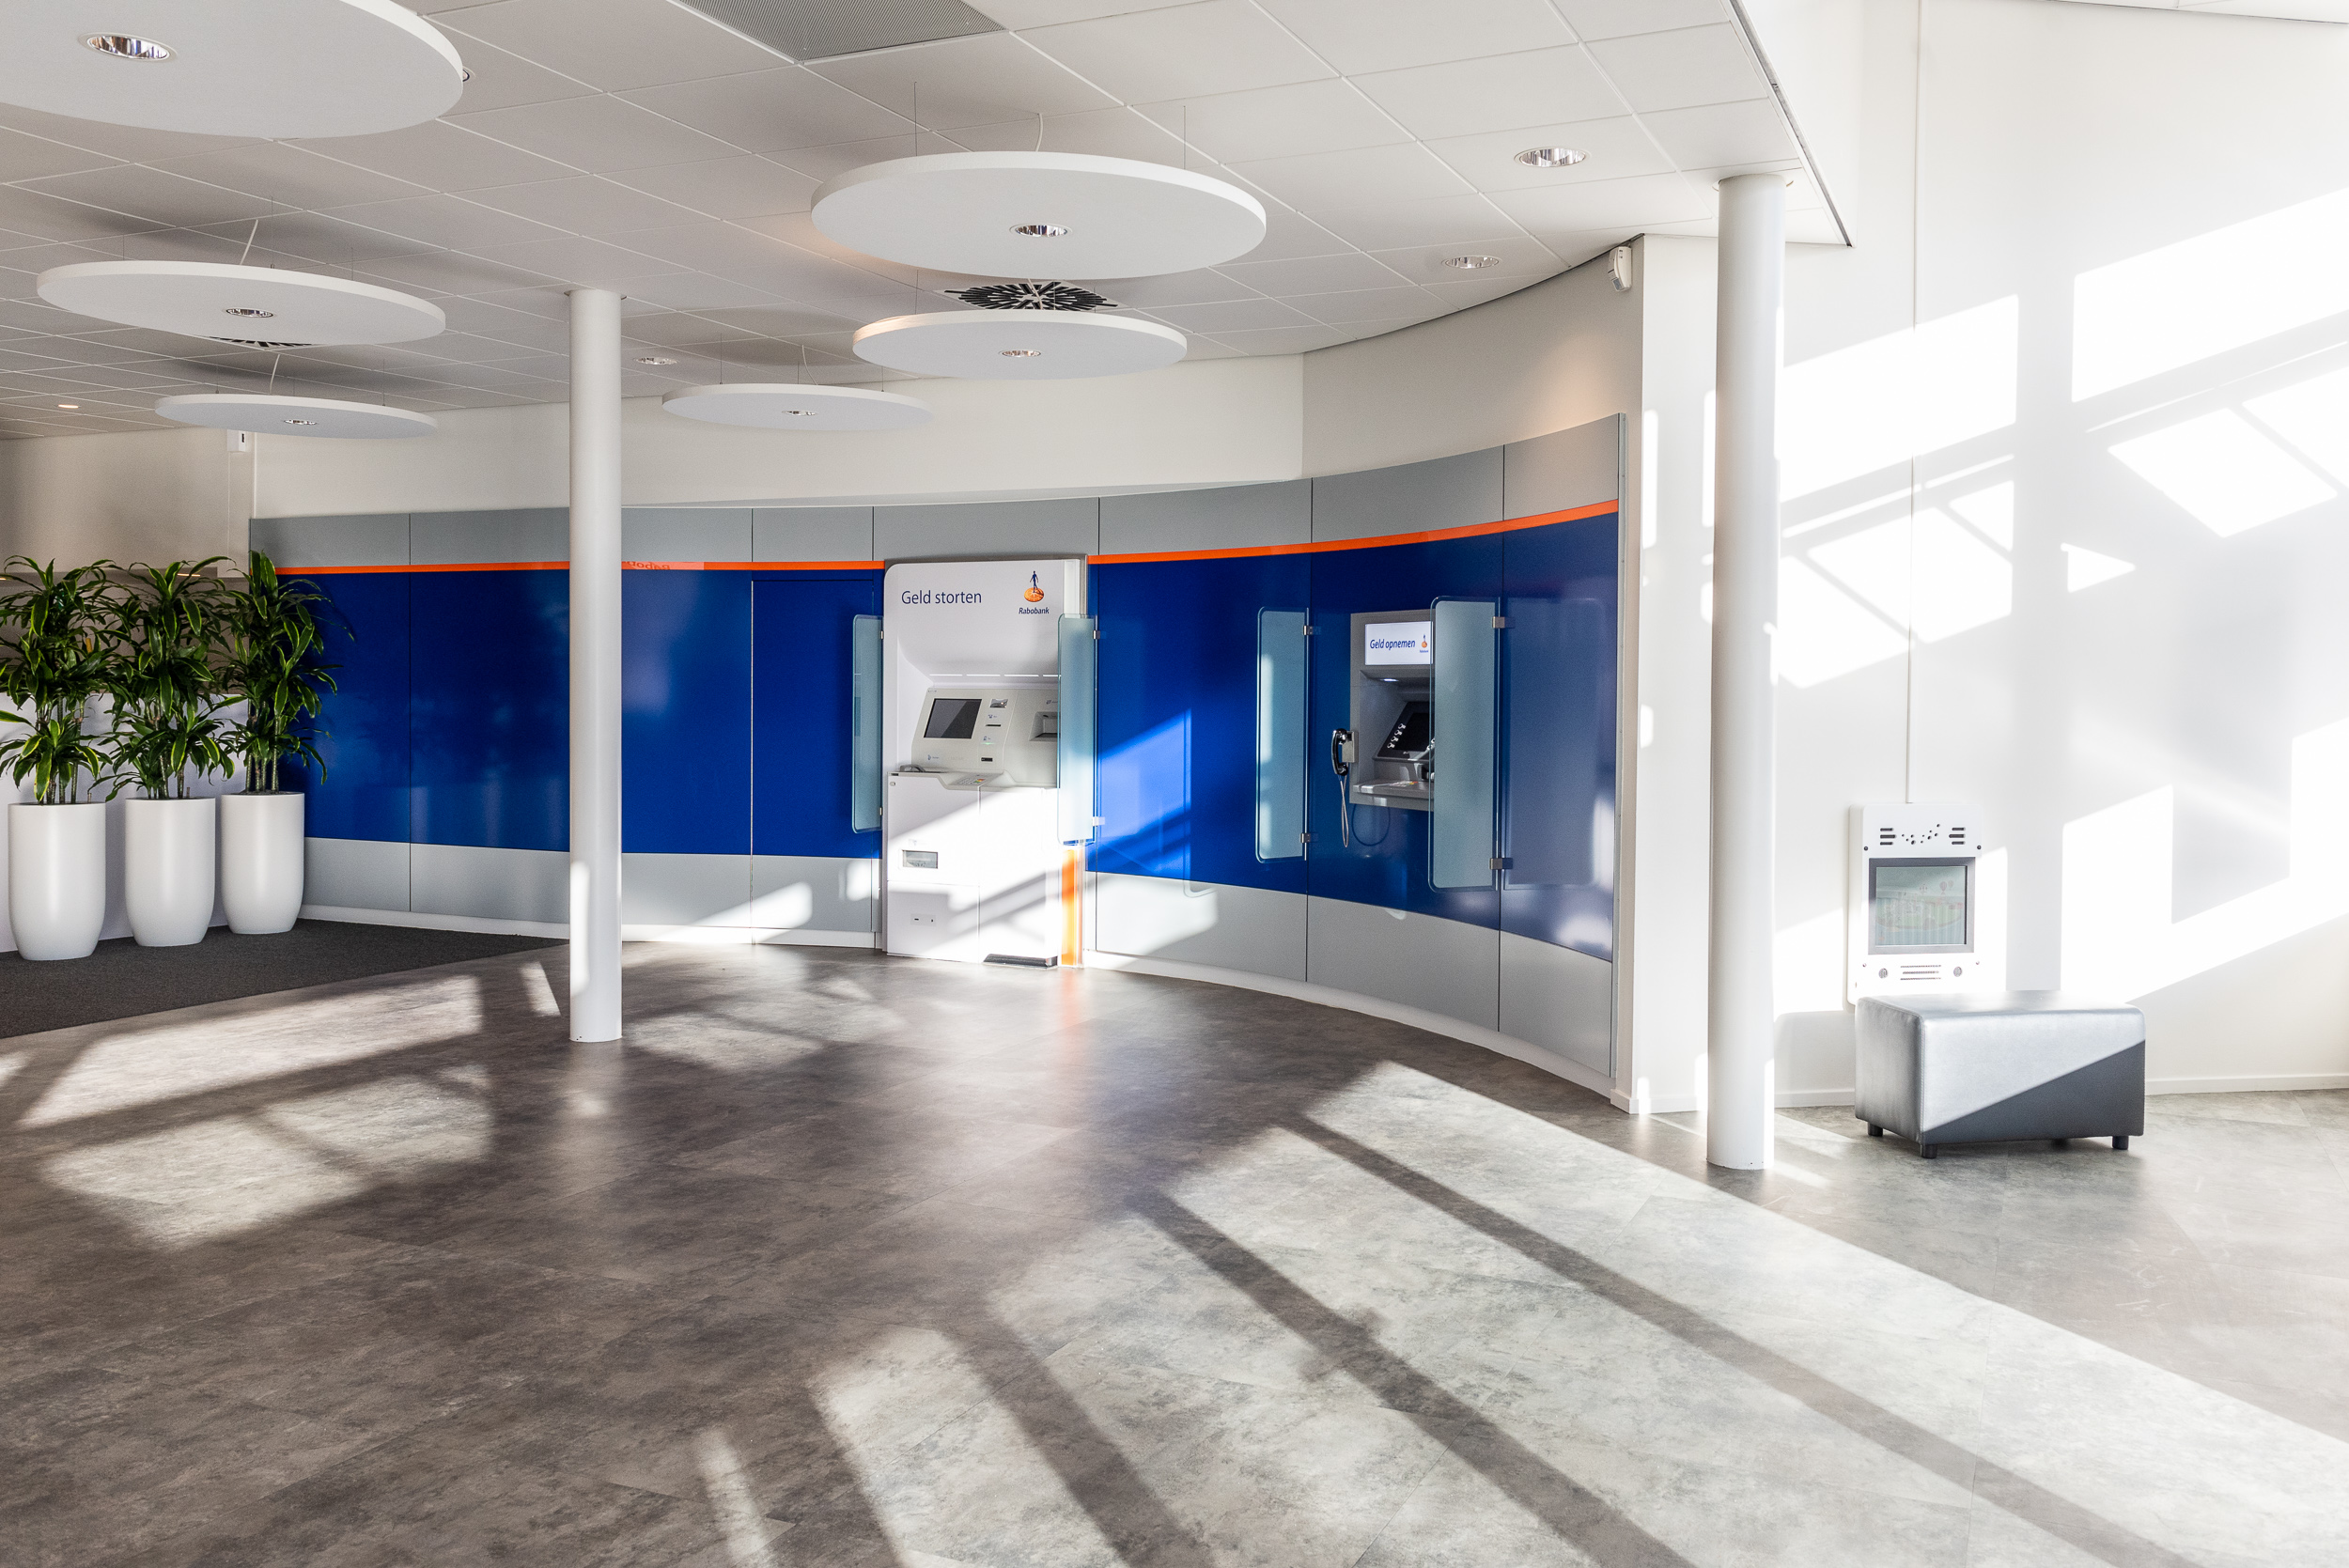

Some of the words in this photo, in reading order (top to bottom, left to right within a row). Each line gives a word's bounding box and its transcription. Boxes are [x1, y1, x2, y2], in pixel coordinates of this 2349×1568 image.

[901, 590, 931, 604] Geld
[935, 591, 982, 604] storten
[1370, 639, 1385, 648] Geld
[1385, 641, 1415, 650] opnemen
